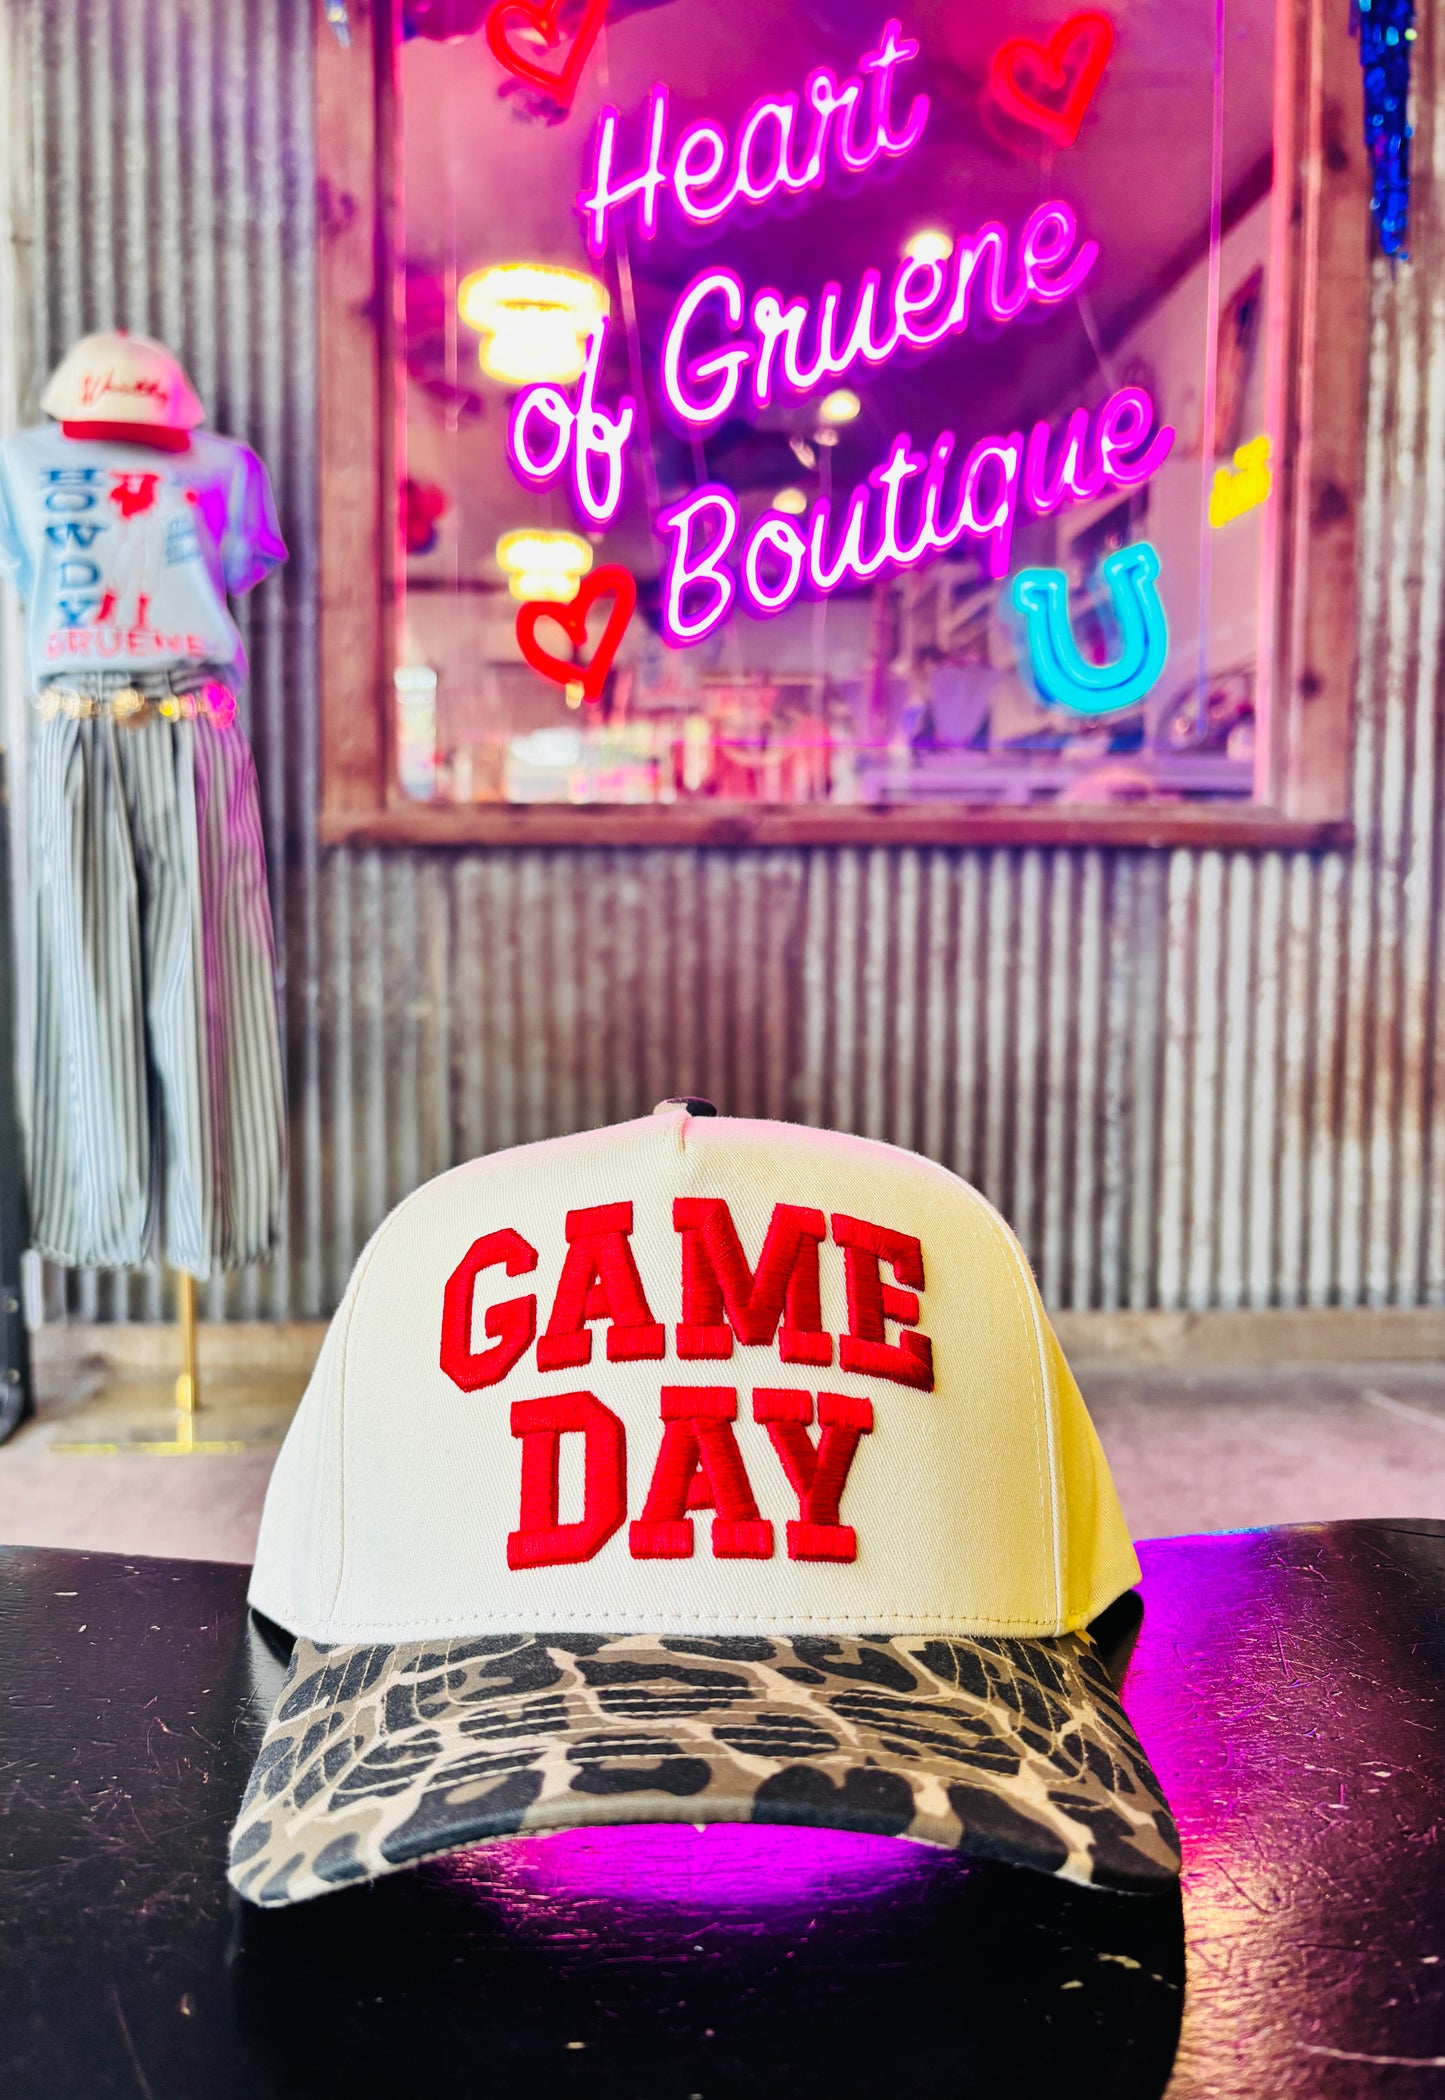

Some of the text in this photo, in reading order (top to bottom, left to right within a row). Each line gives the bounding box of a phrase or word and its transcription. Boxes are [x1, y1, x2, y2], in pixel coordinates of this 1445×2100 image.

[582, 19, 928, 255] Heart
[510, 200, 1099, 522] of Gruene
[39, 467, 105, 628] HOWDY
[662, 386, 1176, 644] Boutique
[47, 630, 205, 657] GRUENE
[440, 1196, 936, 1393] GAME
[507, 1385, 874, 1571] DAY
